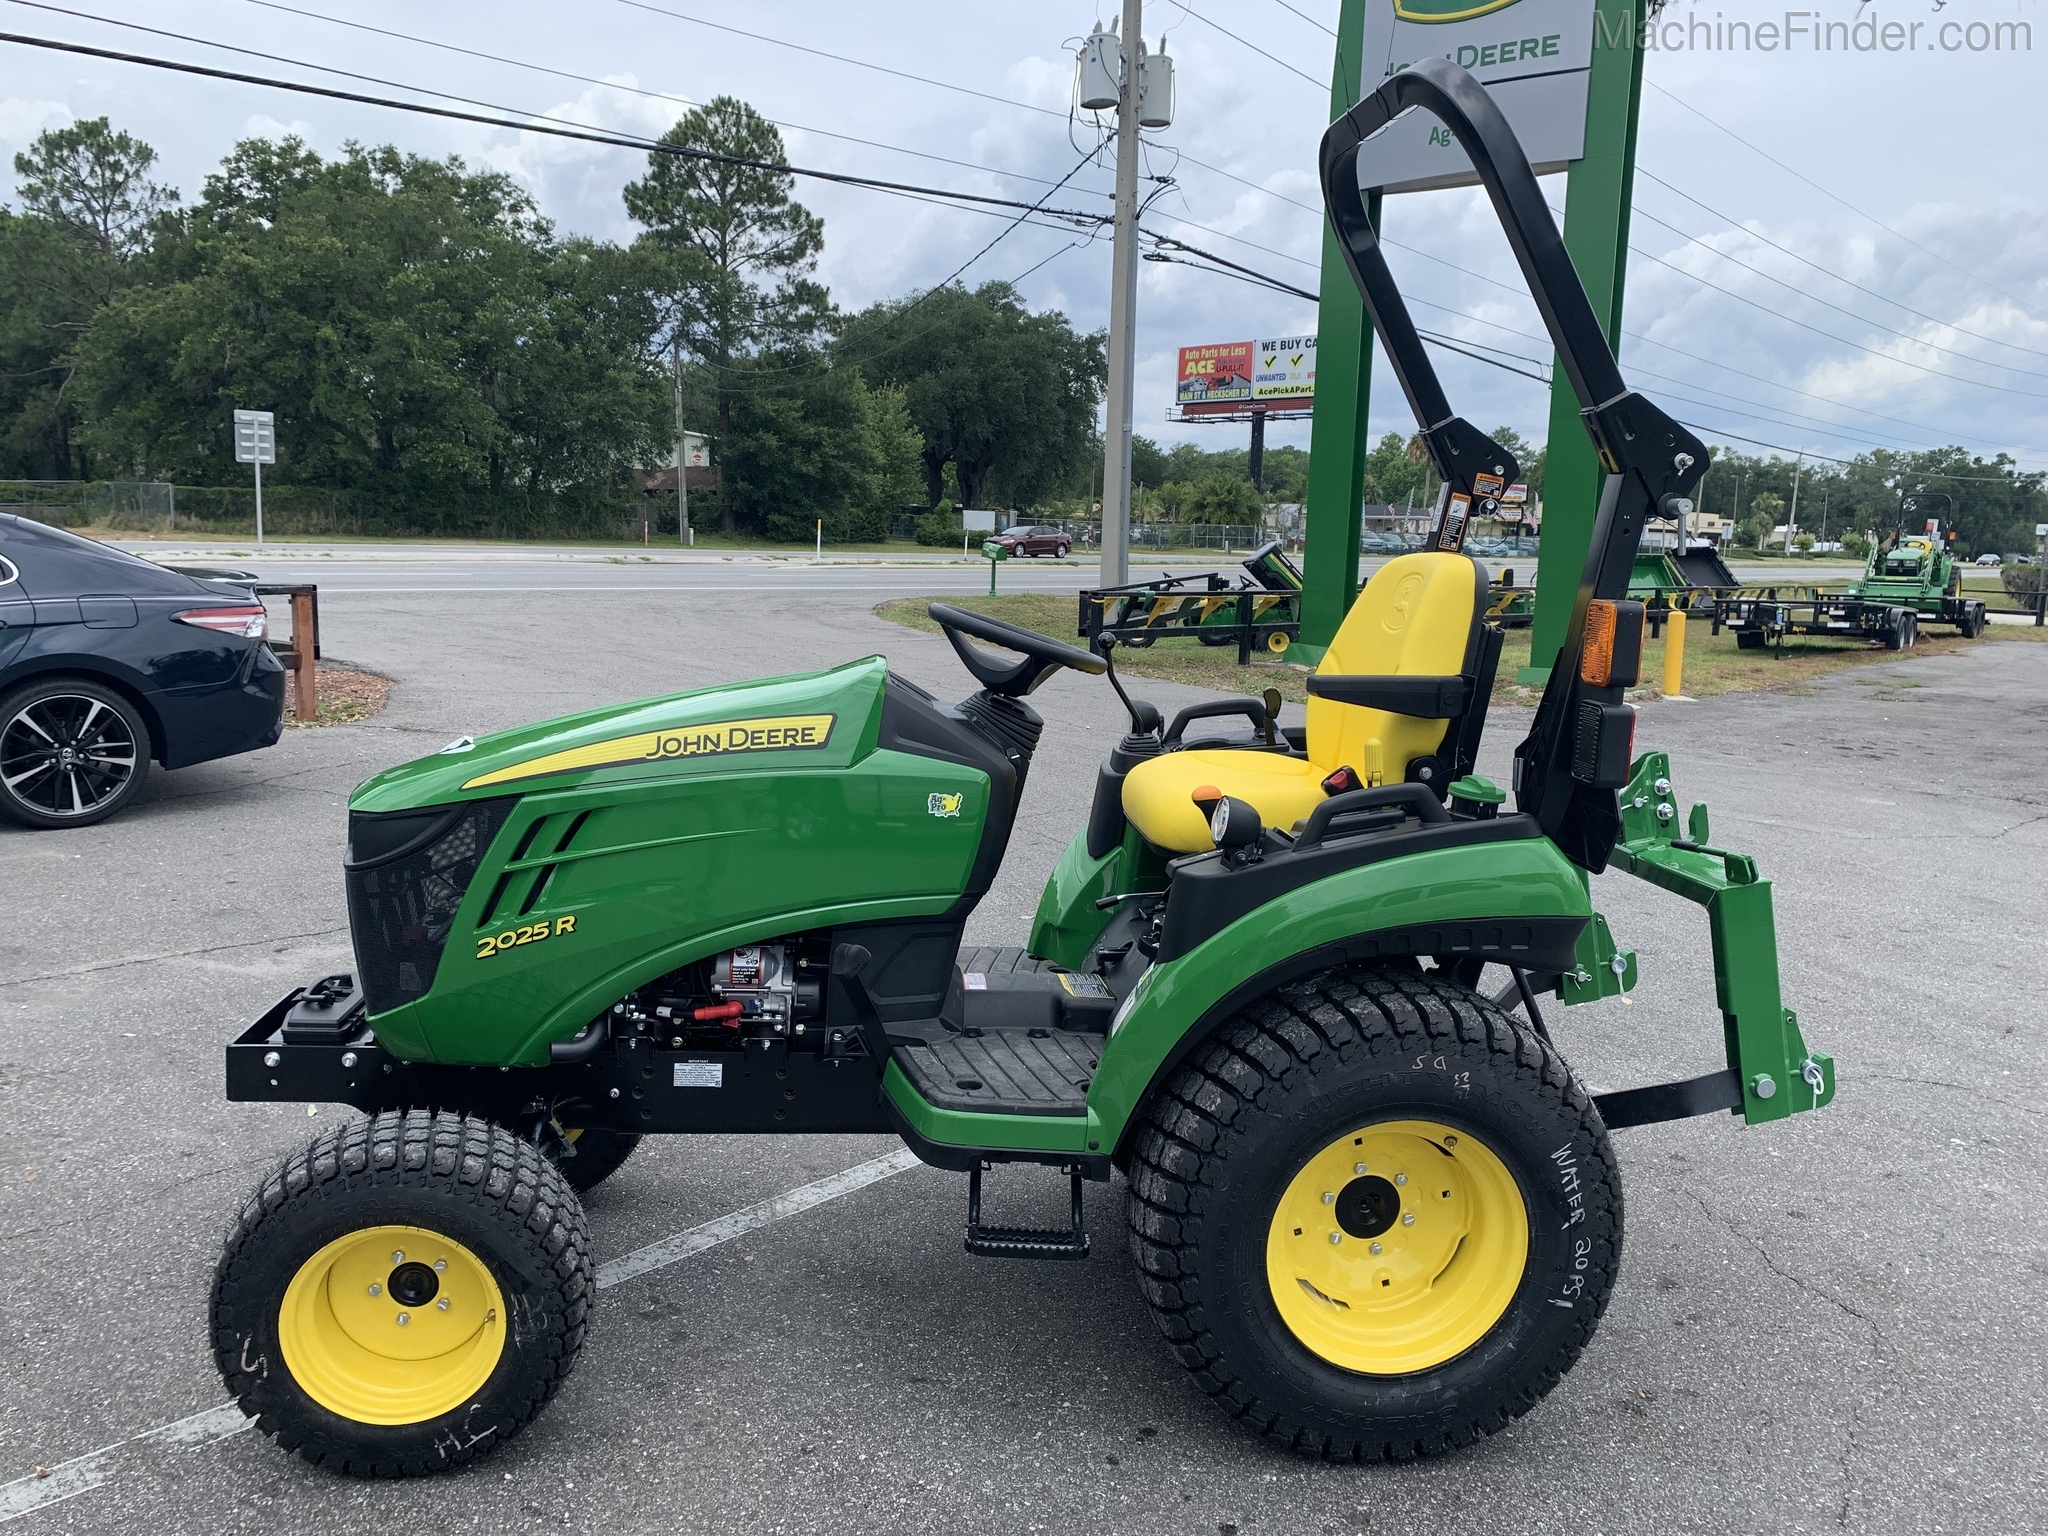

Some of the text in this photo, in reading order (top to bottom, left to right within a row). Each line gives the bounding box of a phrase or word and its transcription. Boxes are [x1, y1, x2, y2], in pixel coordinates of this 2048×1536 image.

[1457, 34, 1561, 69] DEERE
[1262, 338, 1318, 351] WE BUY CA
[1185, 346, 1246, 360] Auto Parts for Less
[1185, 360, 1216, 375] ACE
[1216, 364, 1244, 372] U-PULL-IT
[1256, 373, 1286, 382] UNWANTED
[1180, 388, 1249, 401] MAIN ST & HECKSCHER DR
[646, 726, 816, 760] JOHN DEERE
[930, 795, 946, 804] Ag-
[930, 803, 946, 812] Pro
[476, 914, 578, 959] 2025 R
[1288, 1070, 1550, 1138] MIGHTY MOW
[1550, 1142, 1587, 1230] WATER
[331, 1194, 489, 1234] GALAXY
[1300, 1401, 1460, 1431] GALAXY
